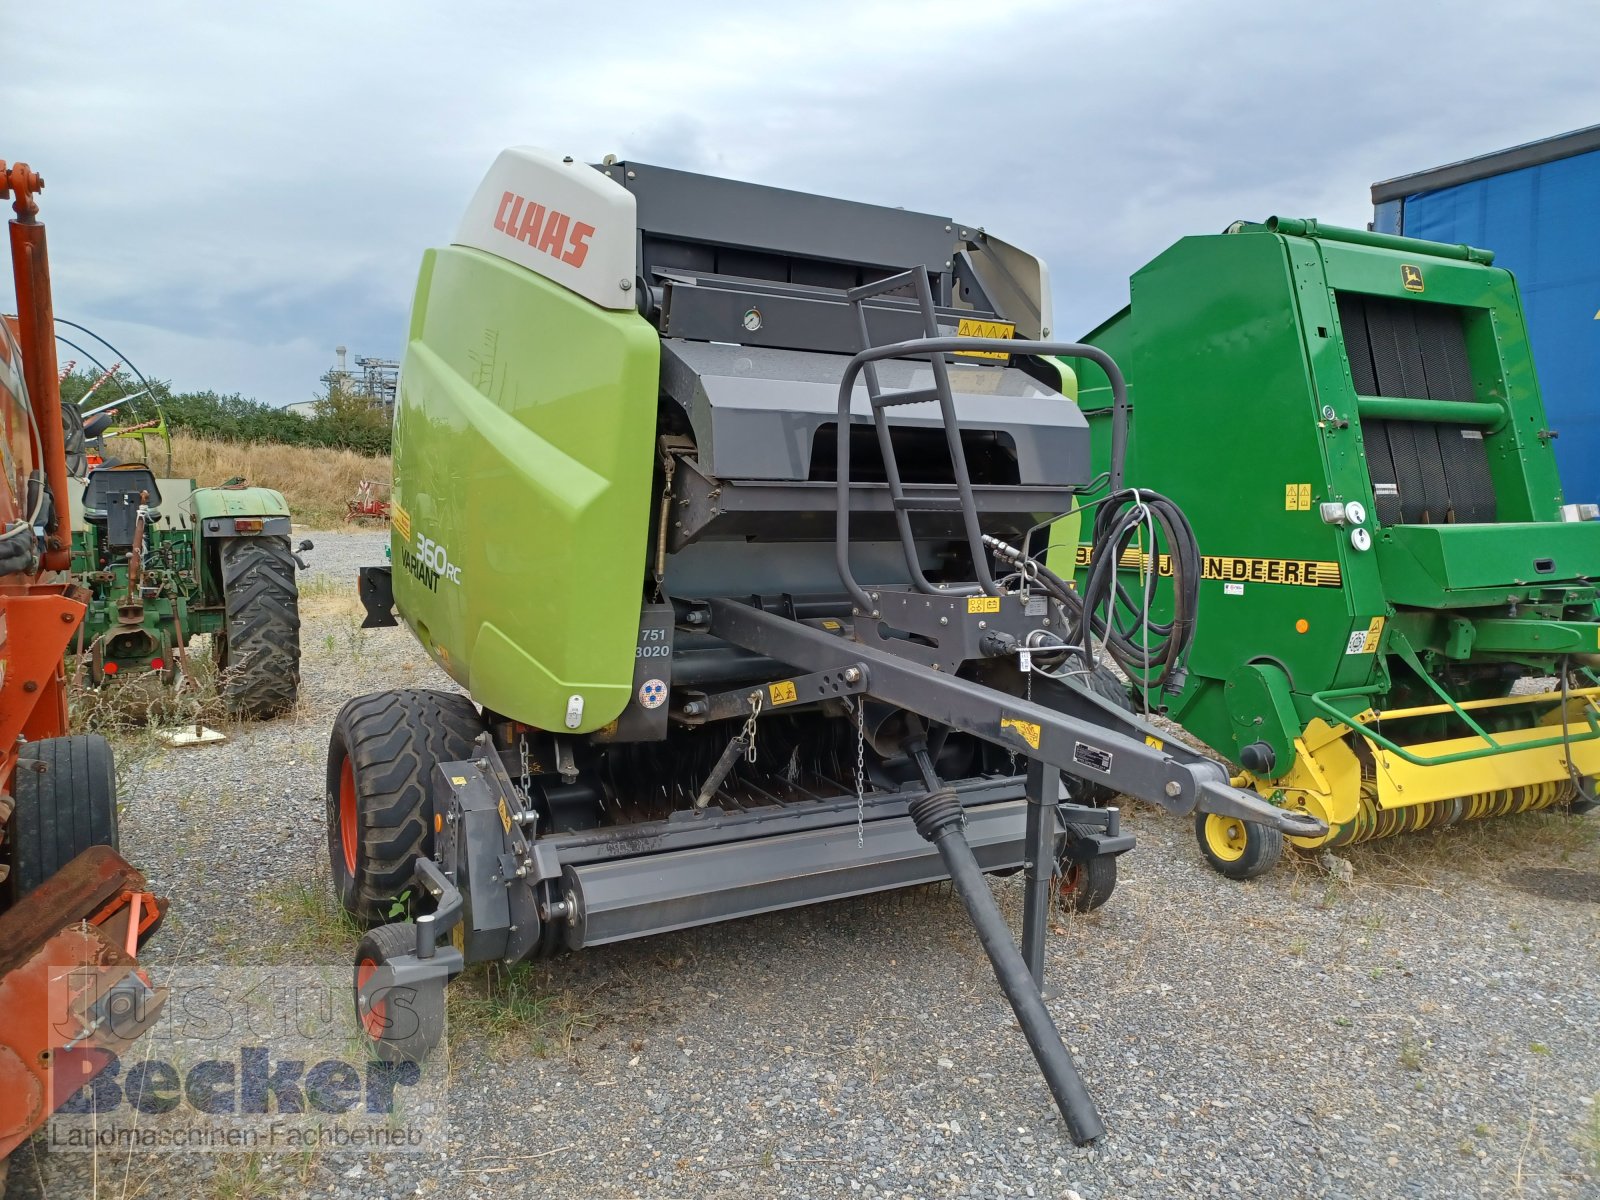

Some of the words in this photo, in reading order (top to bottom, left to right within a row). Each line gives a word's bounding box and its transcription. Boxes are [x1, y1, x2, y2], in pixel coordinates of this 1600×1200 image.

[494, 191, 595, 268] CLAAS
[401, 545, 440, 593] VARIANT
[1160, 556, 1223, 577] JN
[1232, 559, 1317, 584] DEERE
[642, 629, 665, 640] 751
[635, 645, 669, 657] 3020
